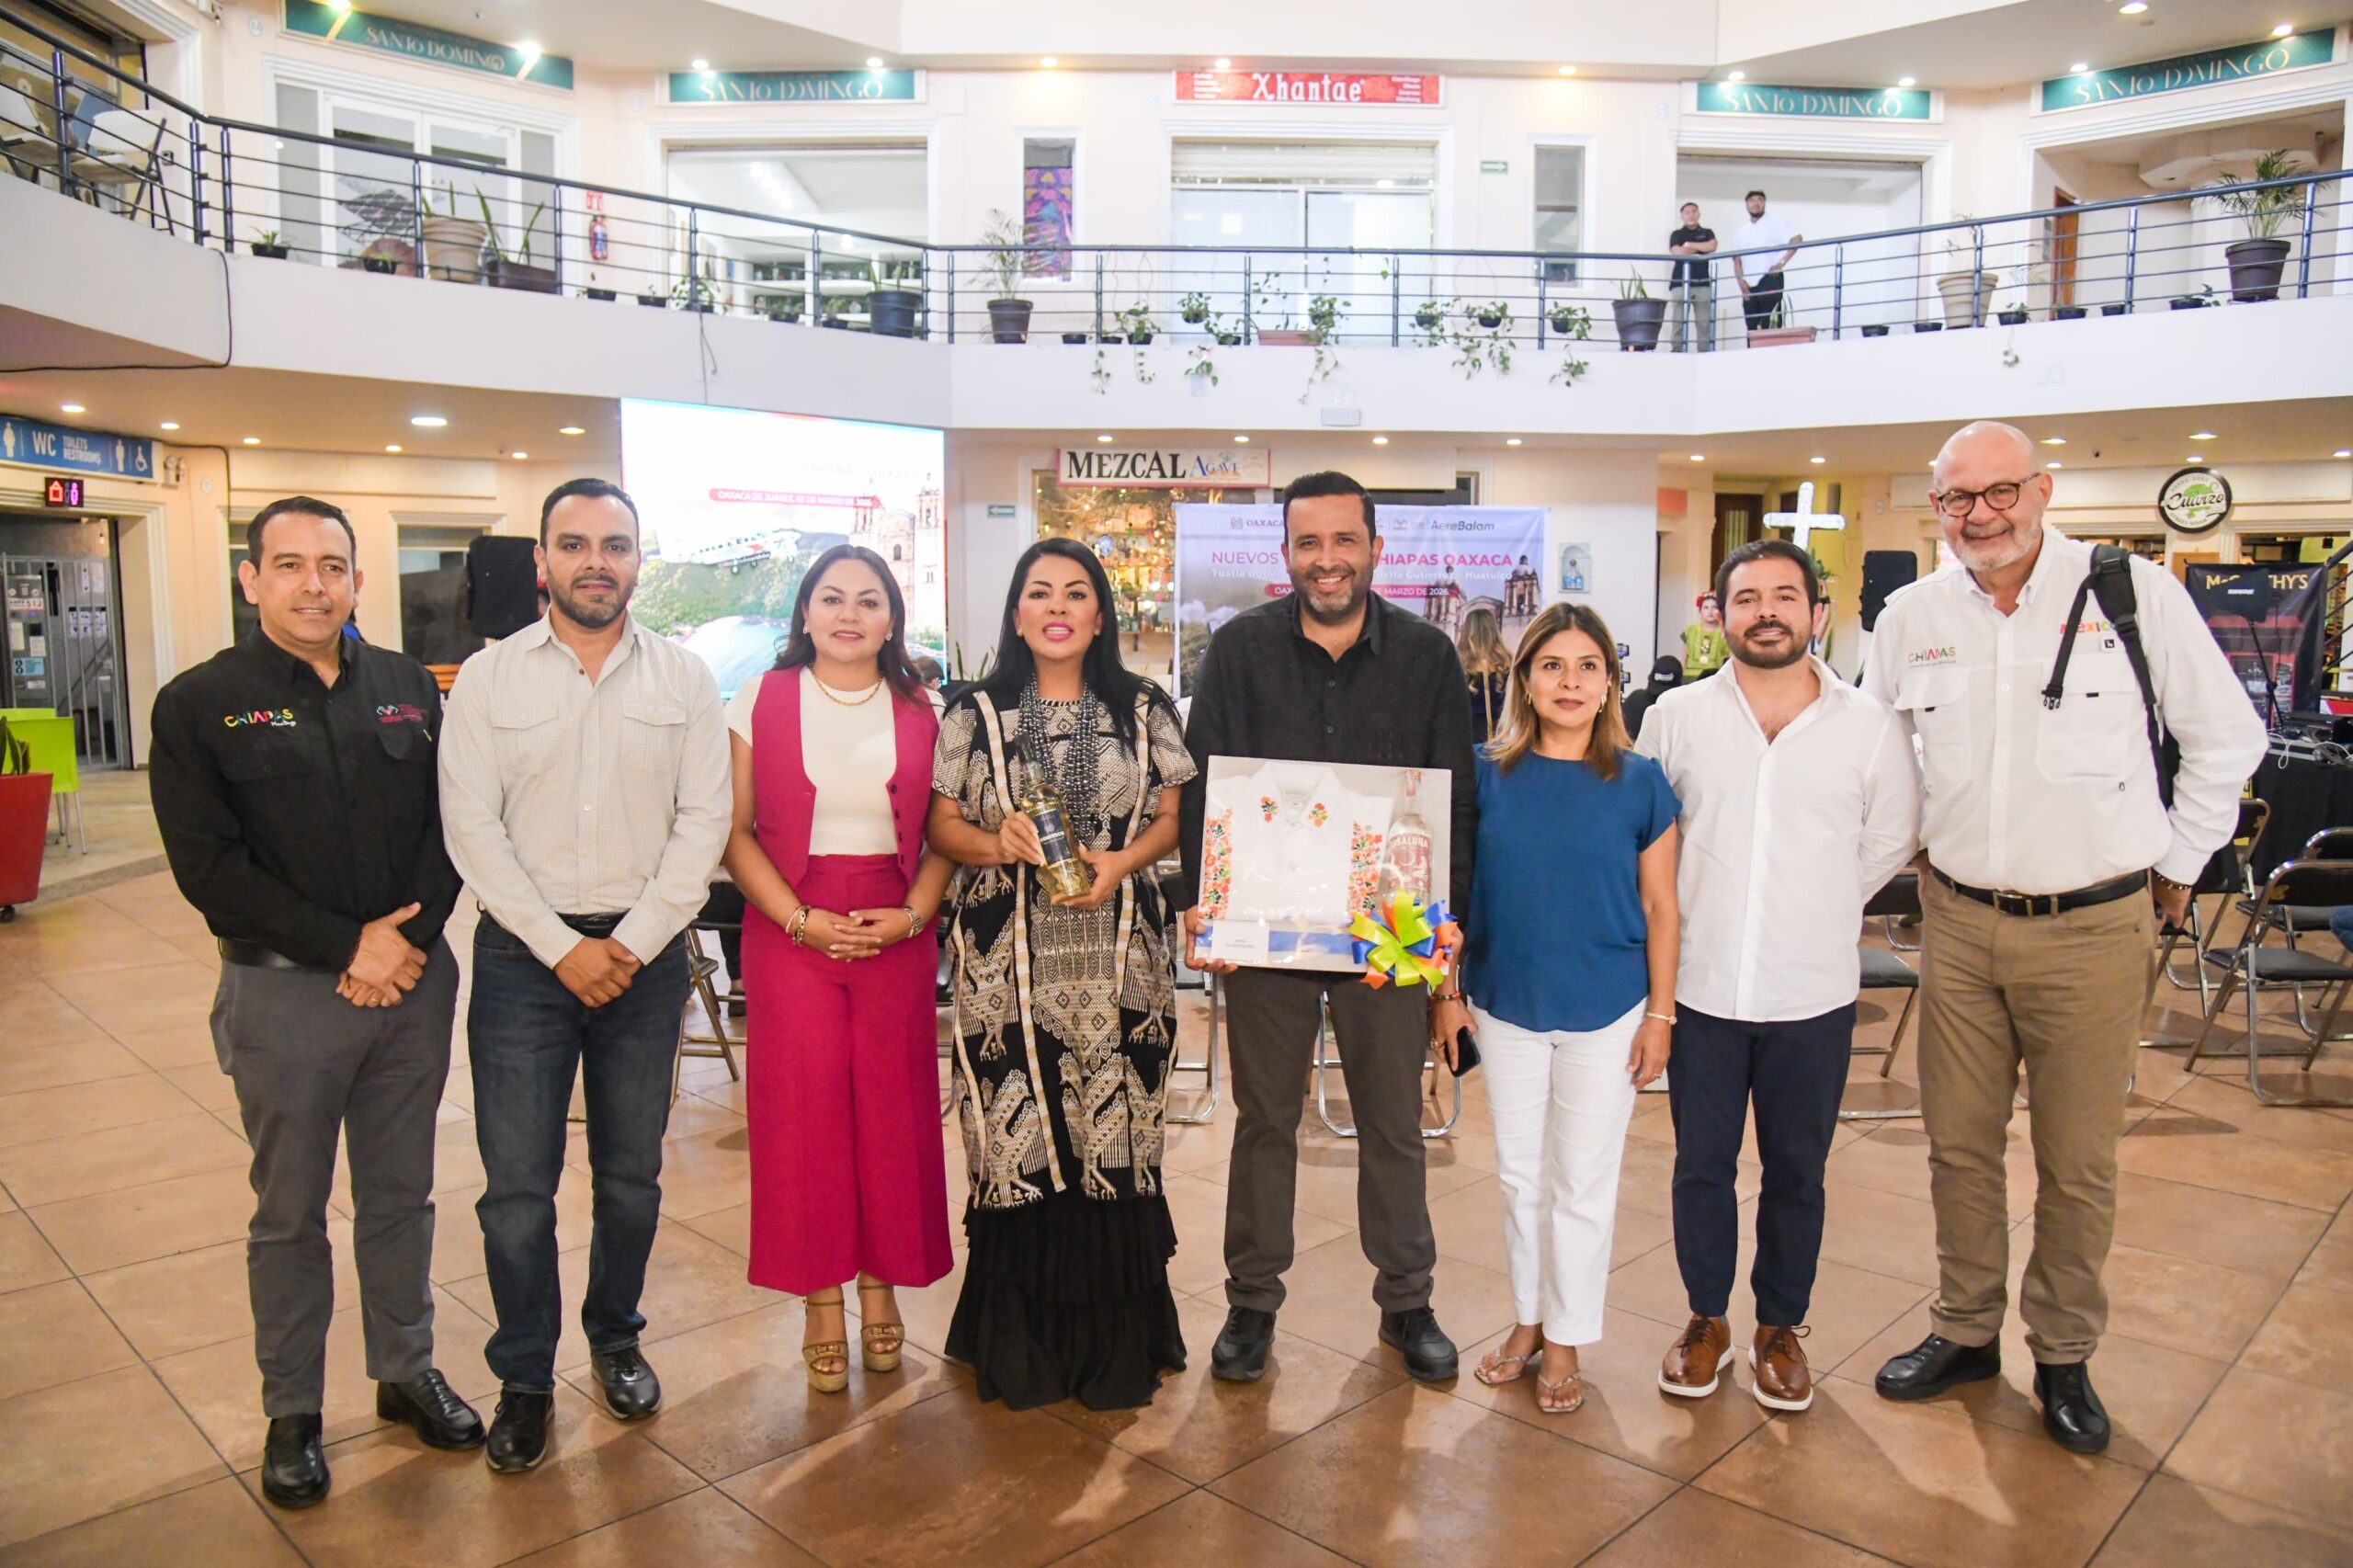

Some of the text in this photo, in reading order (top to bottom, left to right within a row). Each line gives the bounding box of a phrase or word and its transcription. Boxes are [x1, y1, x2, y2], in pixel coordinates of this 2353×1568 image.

[1251, 72, 1362, 102] Xhantae
[32, 431, 56, 457] WC
[63, 435, 88, 449] TOILETS
[63, 448, 102, 465] RESTROOMS
[1067, 450, 1187, 479] MEZCAL
[1430, 520, 1495, 531] AeroBalam
[1211, 551, 1279, 564] NUEVOS
[1380, 553, 1513, 566] HIAPAS OAXACA
[1274, 586, 1295, 595] OAX
[1383, 587, 1415, 596] MARZO
[1907, 645, 1956, 664] CHIAPAS
[223, 708, 294, 728] CHIAPAS
